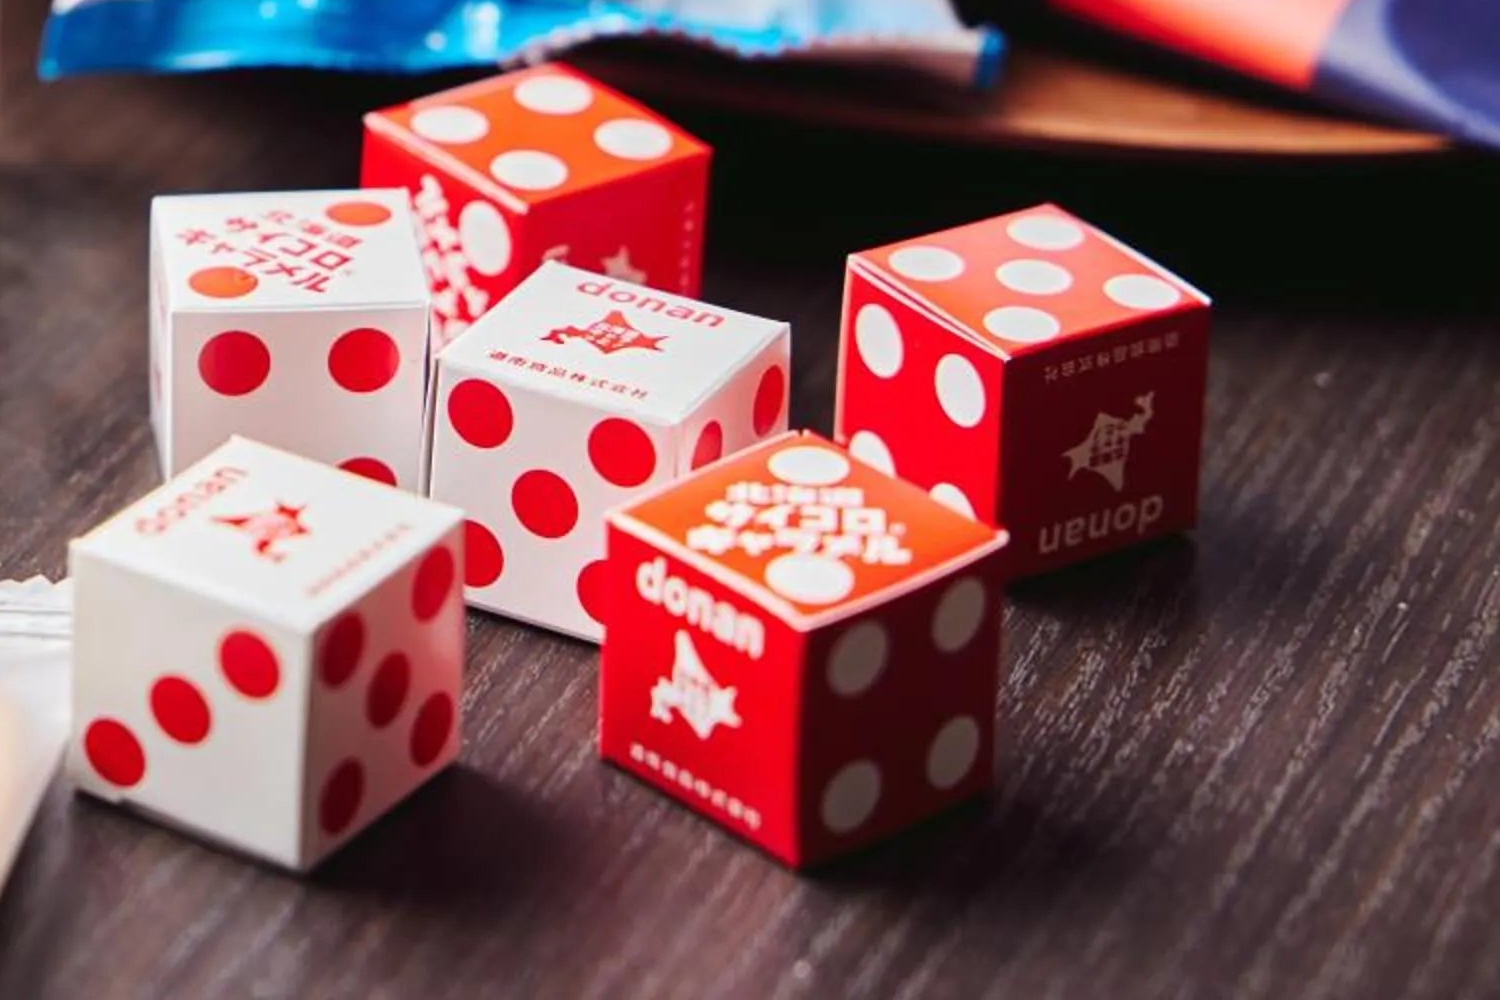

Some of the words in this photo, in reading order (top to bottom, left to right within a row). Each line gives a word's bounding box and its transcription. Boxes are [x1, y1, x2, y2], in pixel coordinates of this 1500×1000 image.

[576, 281, 726, 329] donan
[1038, 494, 1165, 555] donan
[635, 557, 767, 661] donan
